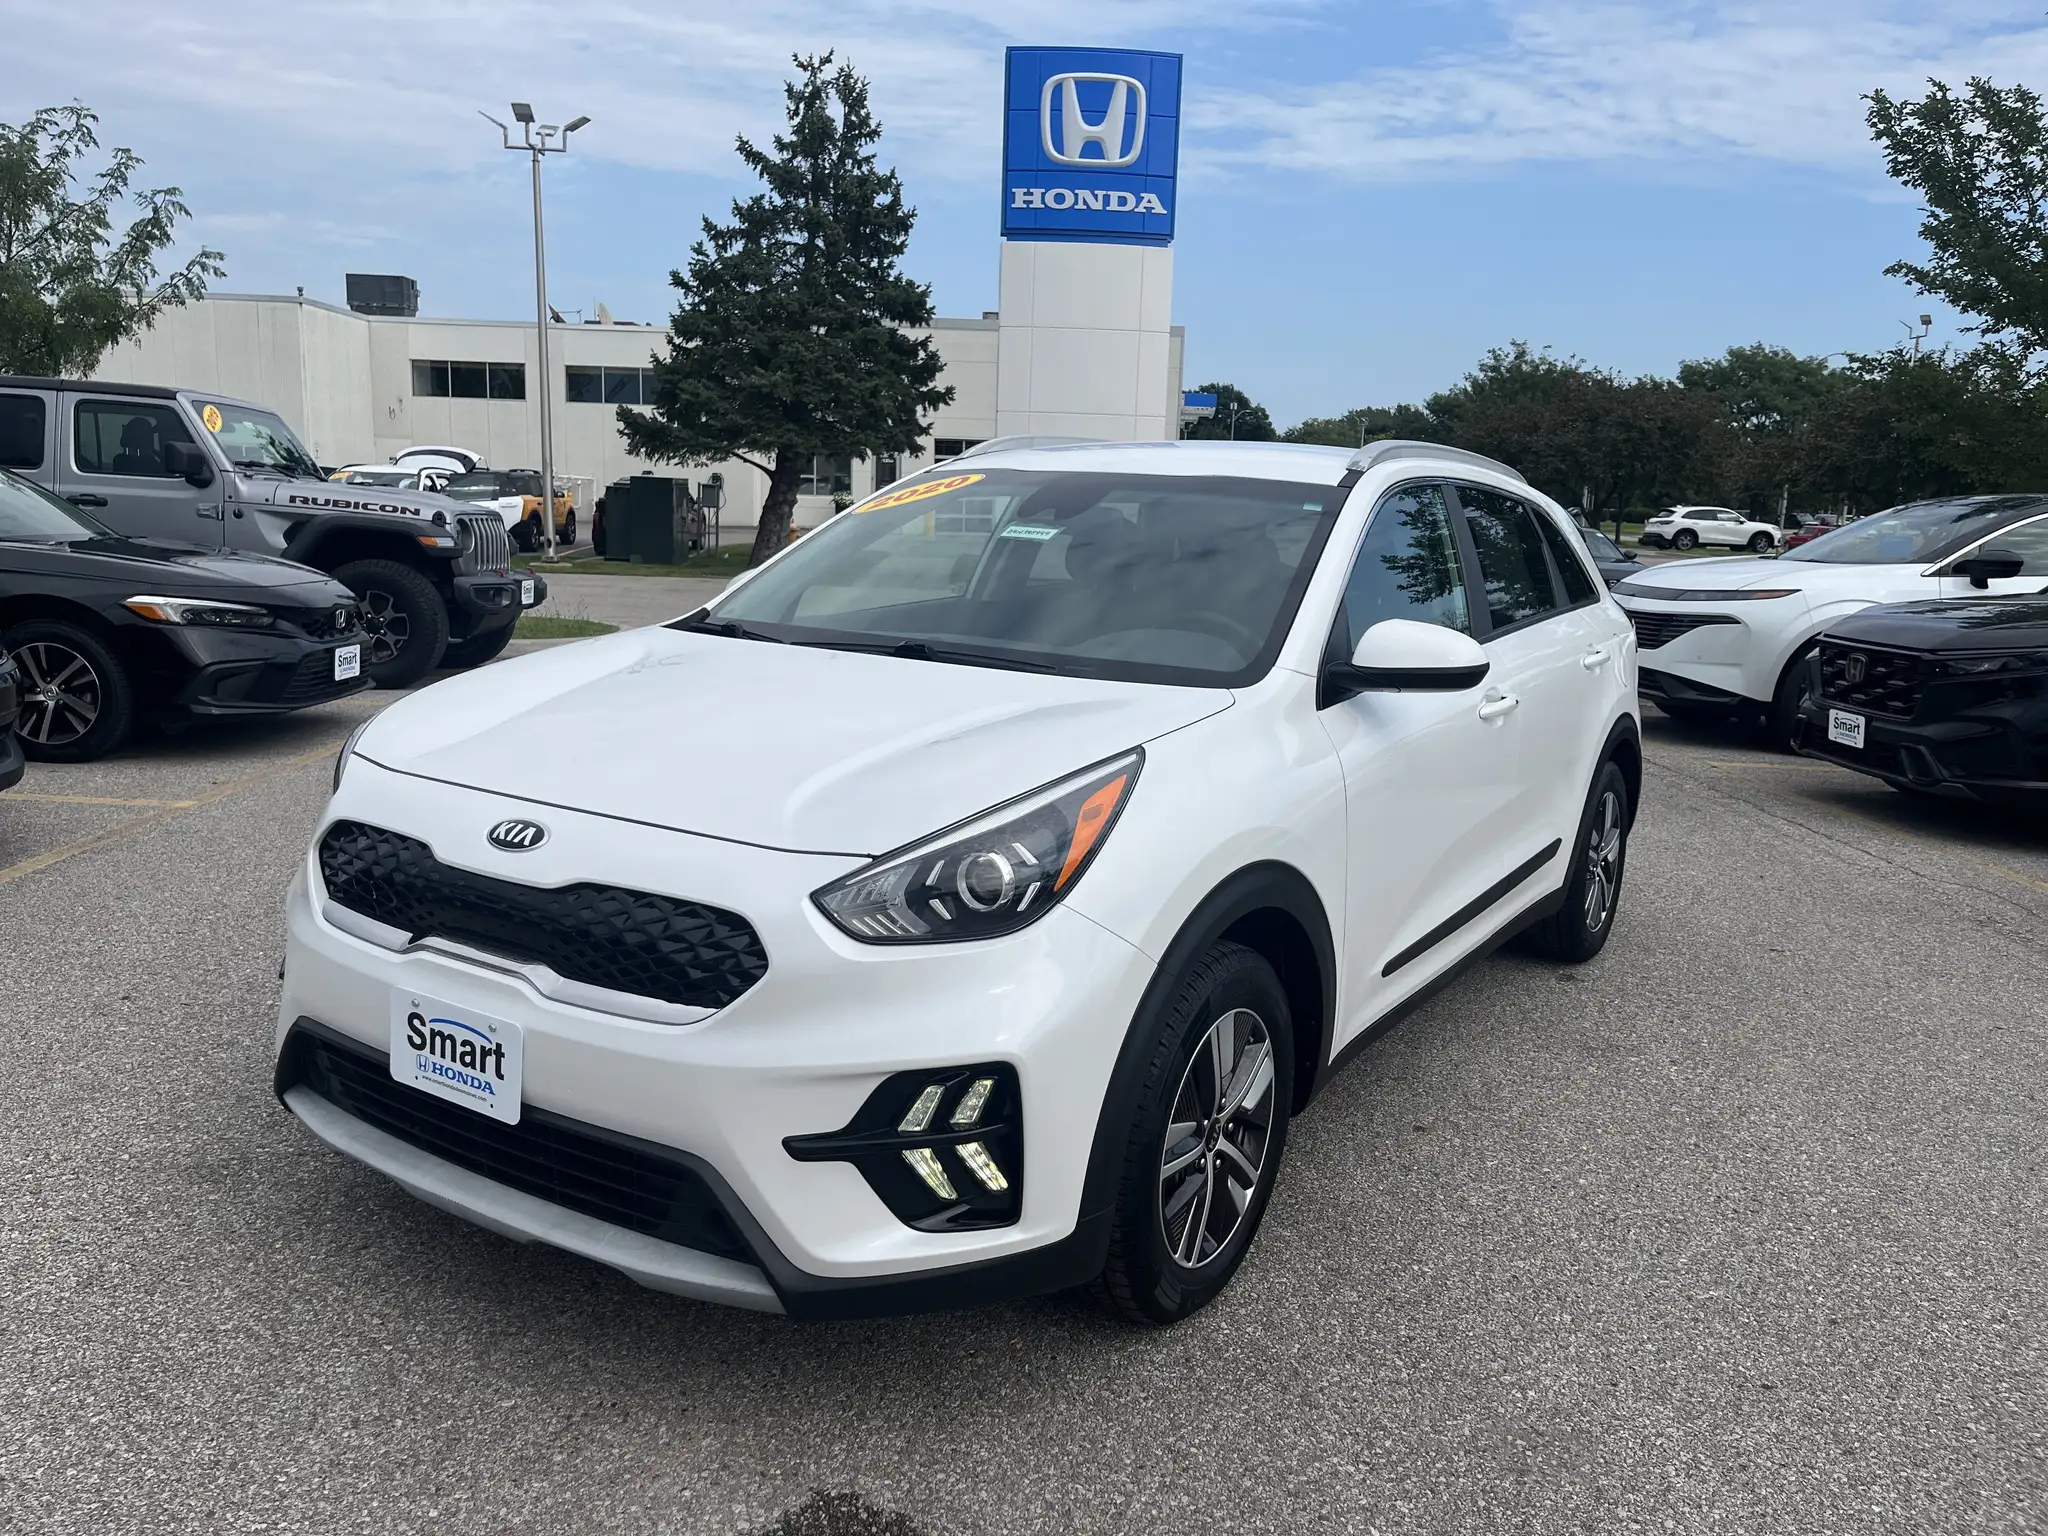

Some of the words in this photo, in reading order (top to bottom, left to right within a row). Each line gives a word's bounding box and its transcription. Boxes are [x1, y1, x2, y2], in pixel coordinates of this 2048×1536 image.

[1011, 188, 1167, 214] HONDA
[289, 495, 421, 516] RUBICON
[864, 476, 971, 512] 2020
[338, 652, 357, 668] Smart
[1834, 717, 1860, 735] Smart
[491, 821, 537, 846] KIA
[407, 1012, 505, 1081] Smart
[431, 1061, 496, 1096] HONDA
